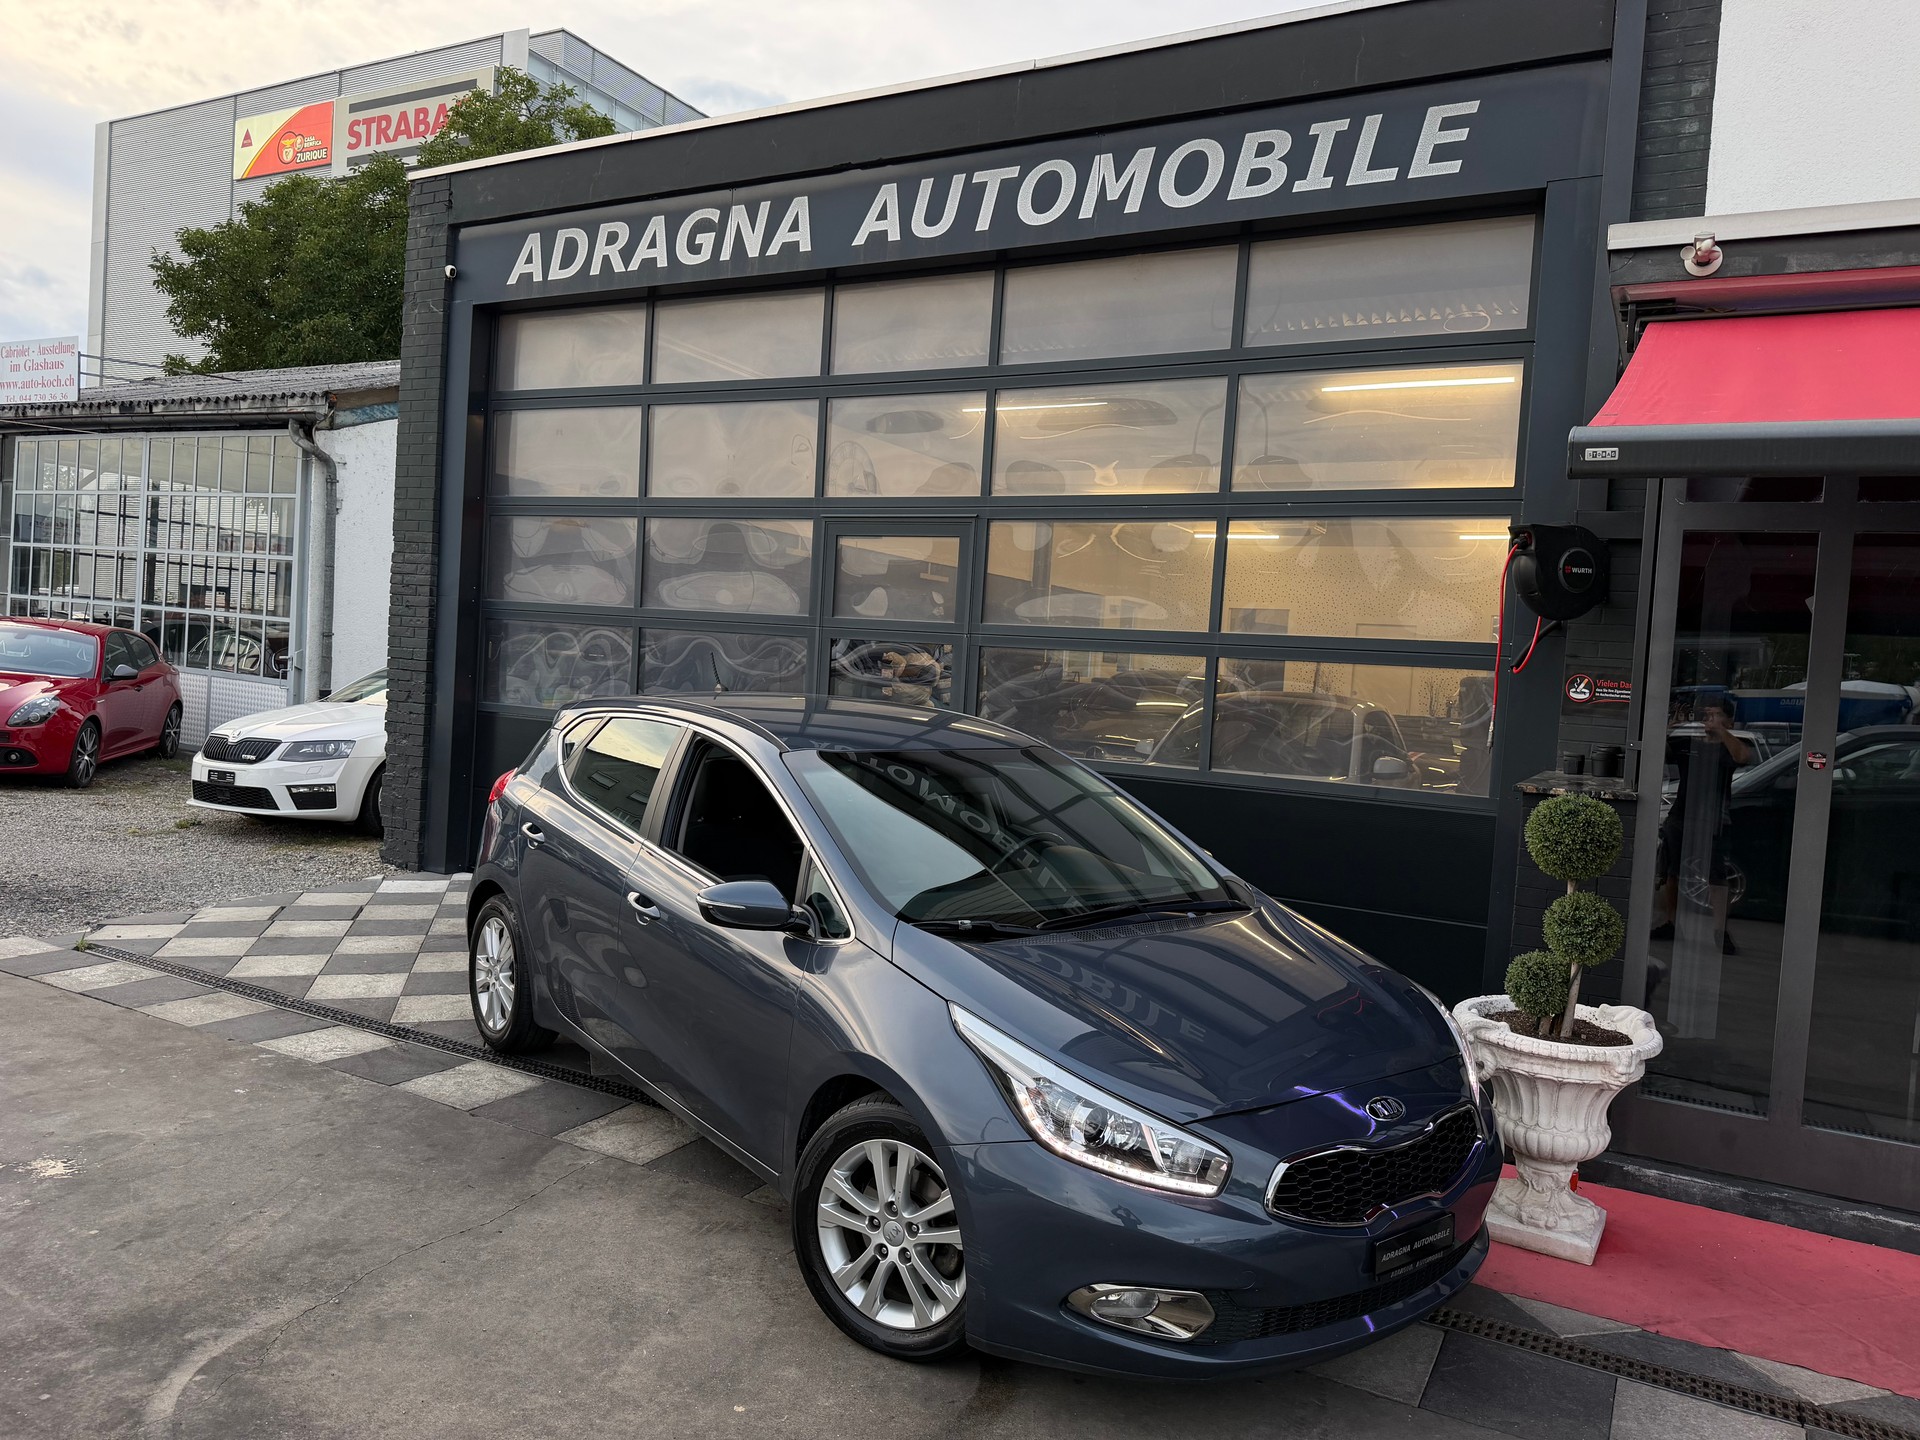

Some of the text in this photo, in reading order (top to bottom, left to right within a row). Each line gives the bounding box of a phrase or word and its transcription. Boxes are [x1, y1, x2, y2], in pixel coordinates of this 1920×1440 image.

[347, 101, 450, 150] STRABA
[296, 148, 328, 163] ZURIQUE
[507, 99, 1481, 285] ADRAGNA AUTOMOBILE
[1, 345, 30, 359] Cabriolet
[37, 341, 75, 356] Ausstellung
[10, 358, 64, 372] im Glashaus
[0, 374, 75, 390] www.auto-koch.ch
[19, 394, 31, 402] 044
[49, 393, 57, 401] 36
[60, 392, 68, 400] 36
[1597, 680, 1618, 688] Vielen
[1381, 1228, 1451, 1262] ADRAGNA AUTOMOBILE
